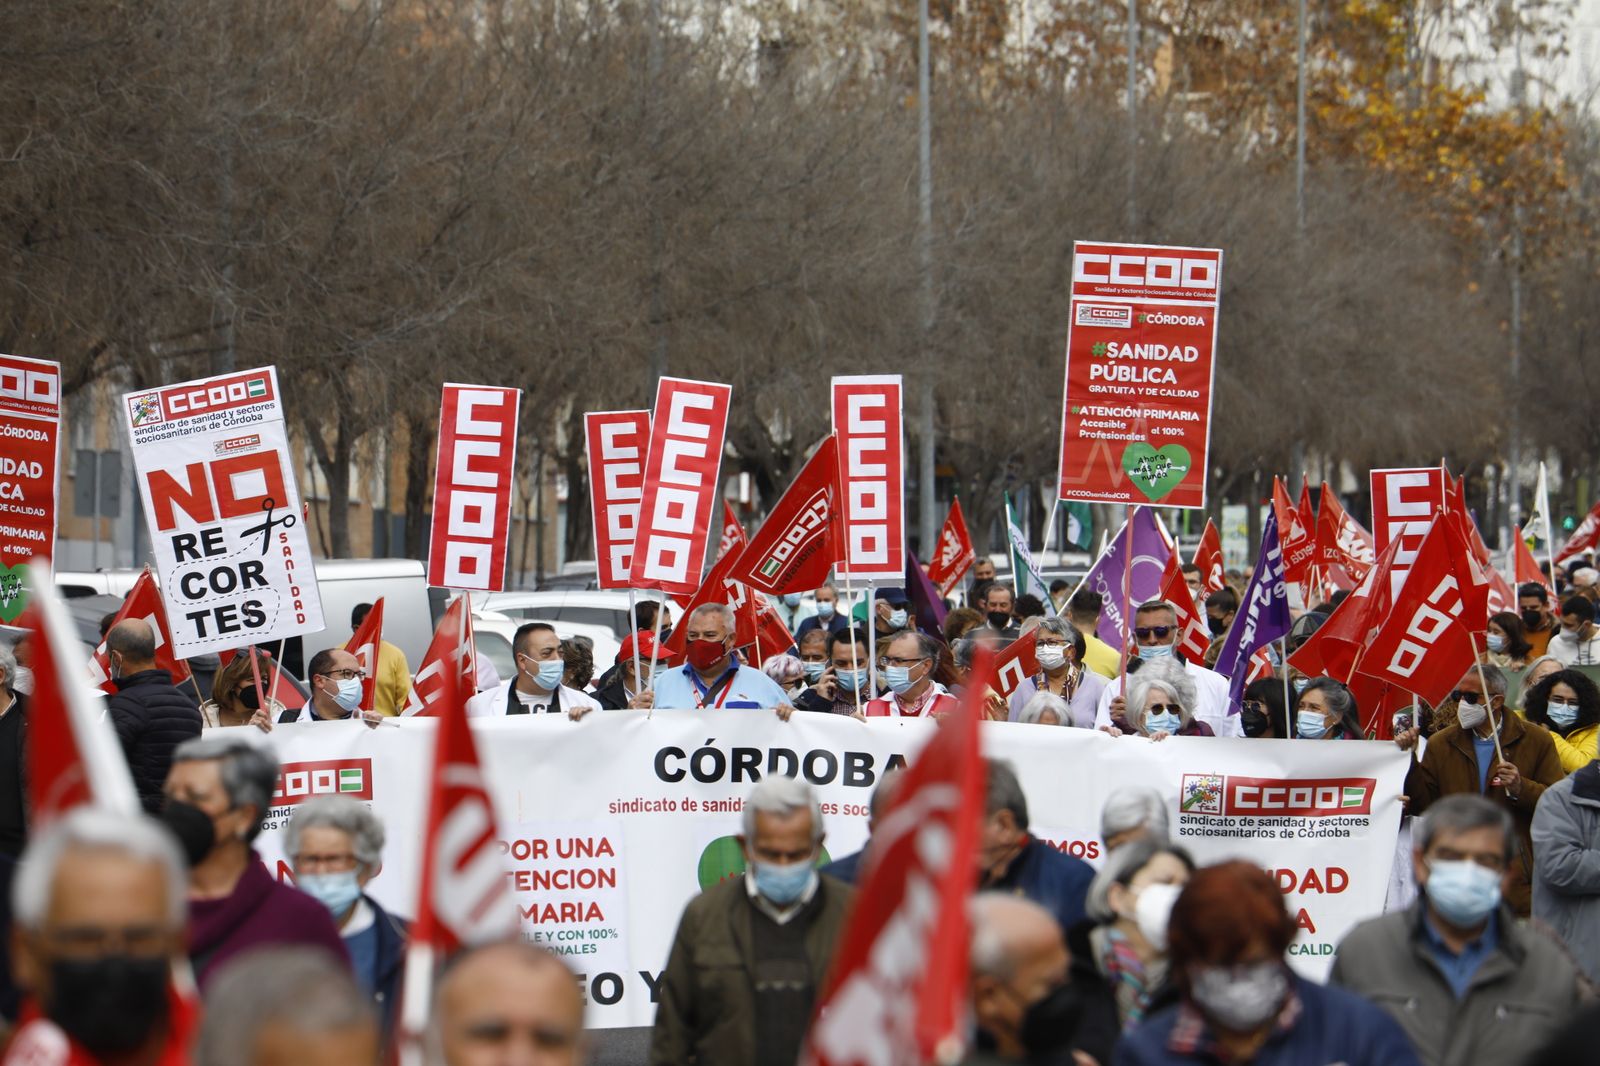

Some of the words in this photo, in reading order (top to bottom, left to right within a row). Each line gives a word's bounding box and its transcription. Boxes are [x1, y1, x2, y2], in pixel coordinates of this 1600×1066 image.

[1074, 253, 1218, 289] CCOO
[1138, 312, 1206, 326] #CÓRDOBA
[1092, 341, 1199, 363] #SANIDAD
[1089, 360, 1178, 385] PÚBLICA
[168, 381, 248, 414] CCOO
[1088, 384, 1136, 395] GRATUITA
[1137, 387, 1144, 395] Y
[1145, 387, 1158, 396] DE
[1159, 388, 1200, 398] CALIDAD
[134, 421, 176, 437] sindicato
[177, 418, 189, 428] de
[191, 411, 227, 426] sanidad
[228, 410, 235, 419] y
[236, 402, 276, 416] sectores
[1071, 405, 1141, 418] #ATENCIÓN
[1143, 409, 1200, 421] PRIMARIA
[136, 424, 207, 445] sociosanitarios
[209, 419, 221, 430] de
[223, 412, 264, 428] Córdoba
[1080, 419, 1127, 430] Accesible
[1151, 426, 1160, 435] al
[1162, 427, 1185, 436] 100%
[225, 436, 251, 449] CCOO
[1079, 430, 1146, 441] Profesionales
[1138, 454, 1166, 464] Ahora
[1156, 462, 1172, 472] que
[643, 390, 715, 583] CCOO
[847, 393, 889, 565] CCOO
[1141, 472, 1168, 482] nunca
[146, 449, 290, 533] NO
[443, 389, 504, 590] CCOO
[9, 505, 46, 517] CALIDAD
[3, 544, 11, 553] al
[13, 545, 33, 556] 100%
[171, 527, 228, 563] RE
[180, 560, 269, 600] COR
[279, 532, 306, 625] SANIDAD
[186, 600, 267, 639] TES
[609, 799, 677, 814] sindicato
[681, 797, 698, 812] de
[1235, 785, 1339, 809] CCOO
[1180, 815, 1236, 828] sindicato
[1239, 816, 1255, 827] de
[1258, 816, 1306, 829] sanidad
[1308, 819, 1316, 830] y
[1318, 816, 1370, 828] sectores
[1179, 827, 1276, 839] sociosanitarios
[1280, 826, 1294, 839] de
[1298, 827, 1350, 839] Córdoba
[555, 837, 615, 859] UNA
[546, 932, 554, 942] Y
[557, 930, 585, 941] CON
[588, 928, 619, 940] 100%
